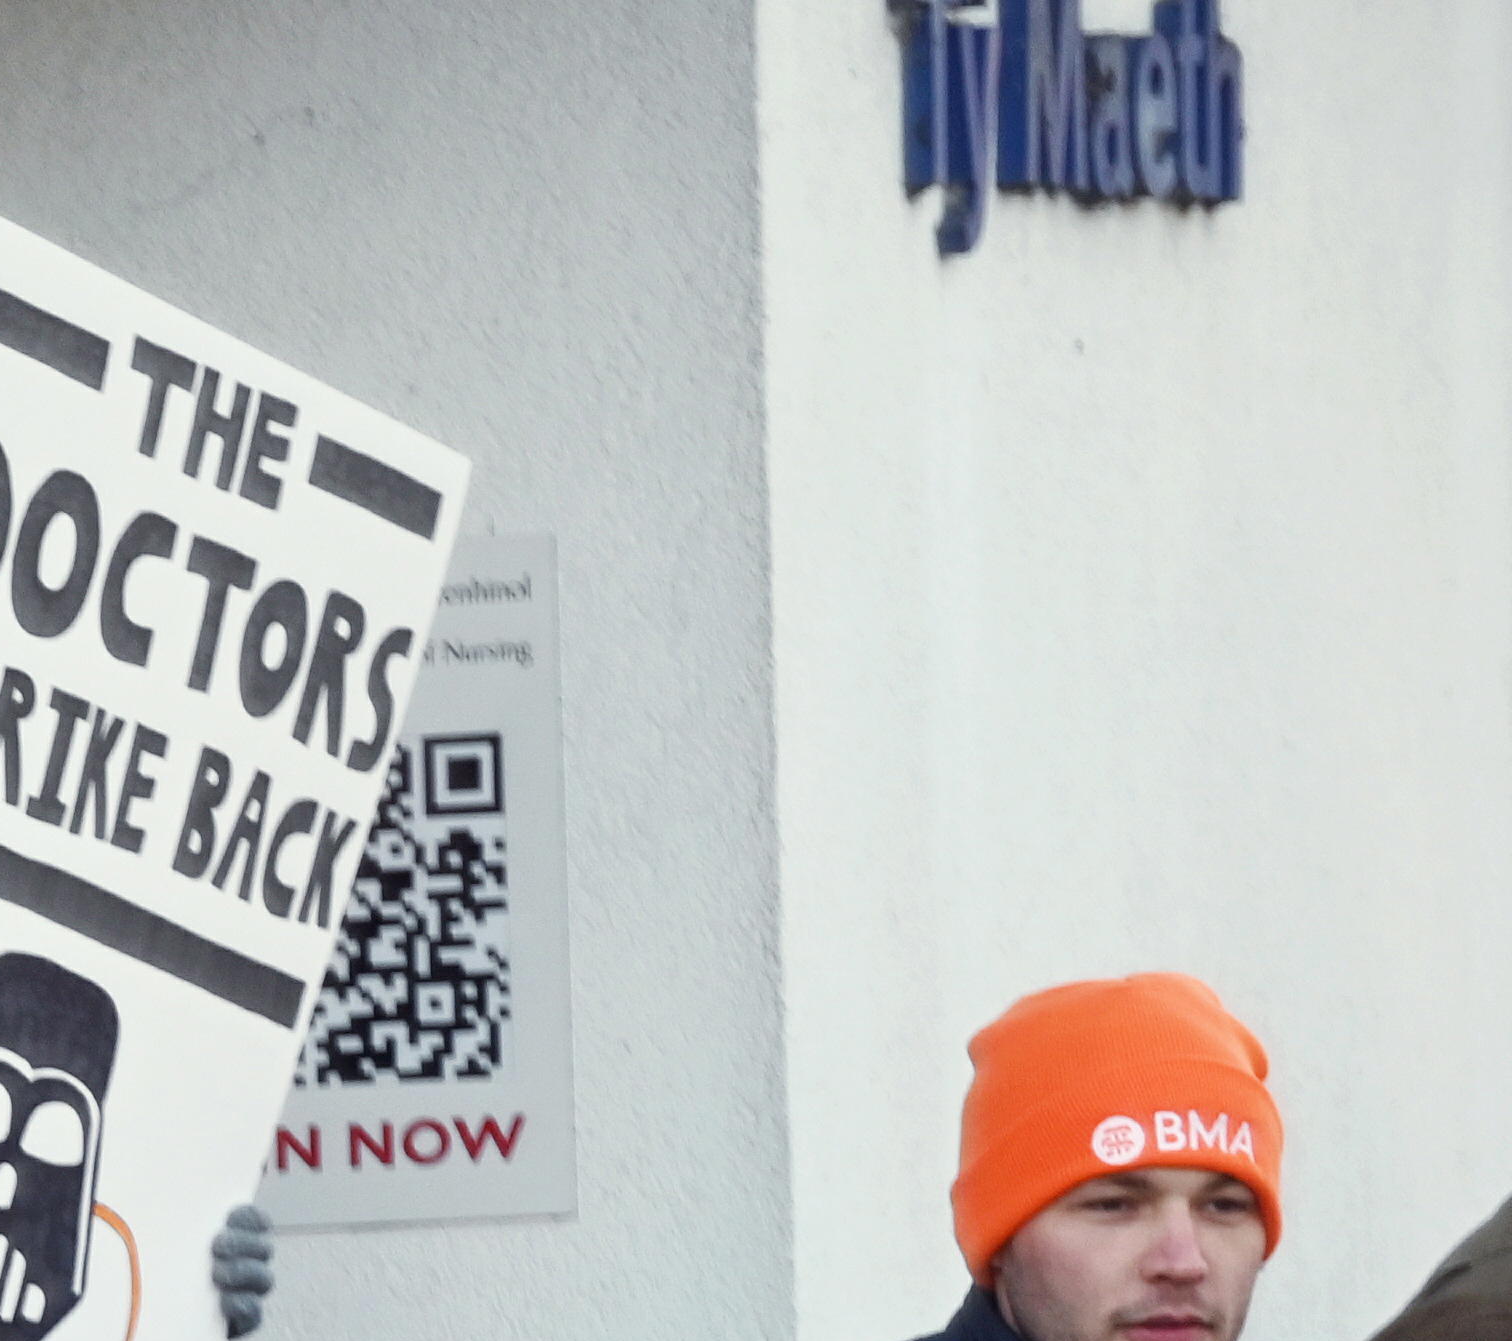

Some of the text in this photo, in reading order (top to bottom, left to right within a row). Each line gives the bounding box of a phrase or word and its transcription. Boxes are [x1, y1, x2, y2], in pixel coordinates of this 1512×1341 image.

[130, 334, 298, 511] THE
[172, 746, 358, 929] BACK
[348, 1113, 527, 1169] NOW
[1154, 1109, 1256, 1163] BMA
